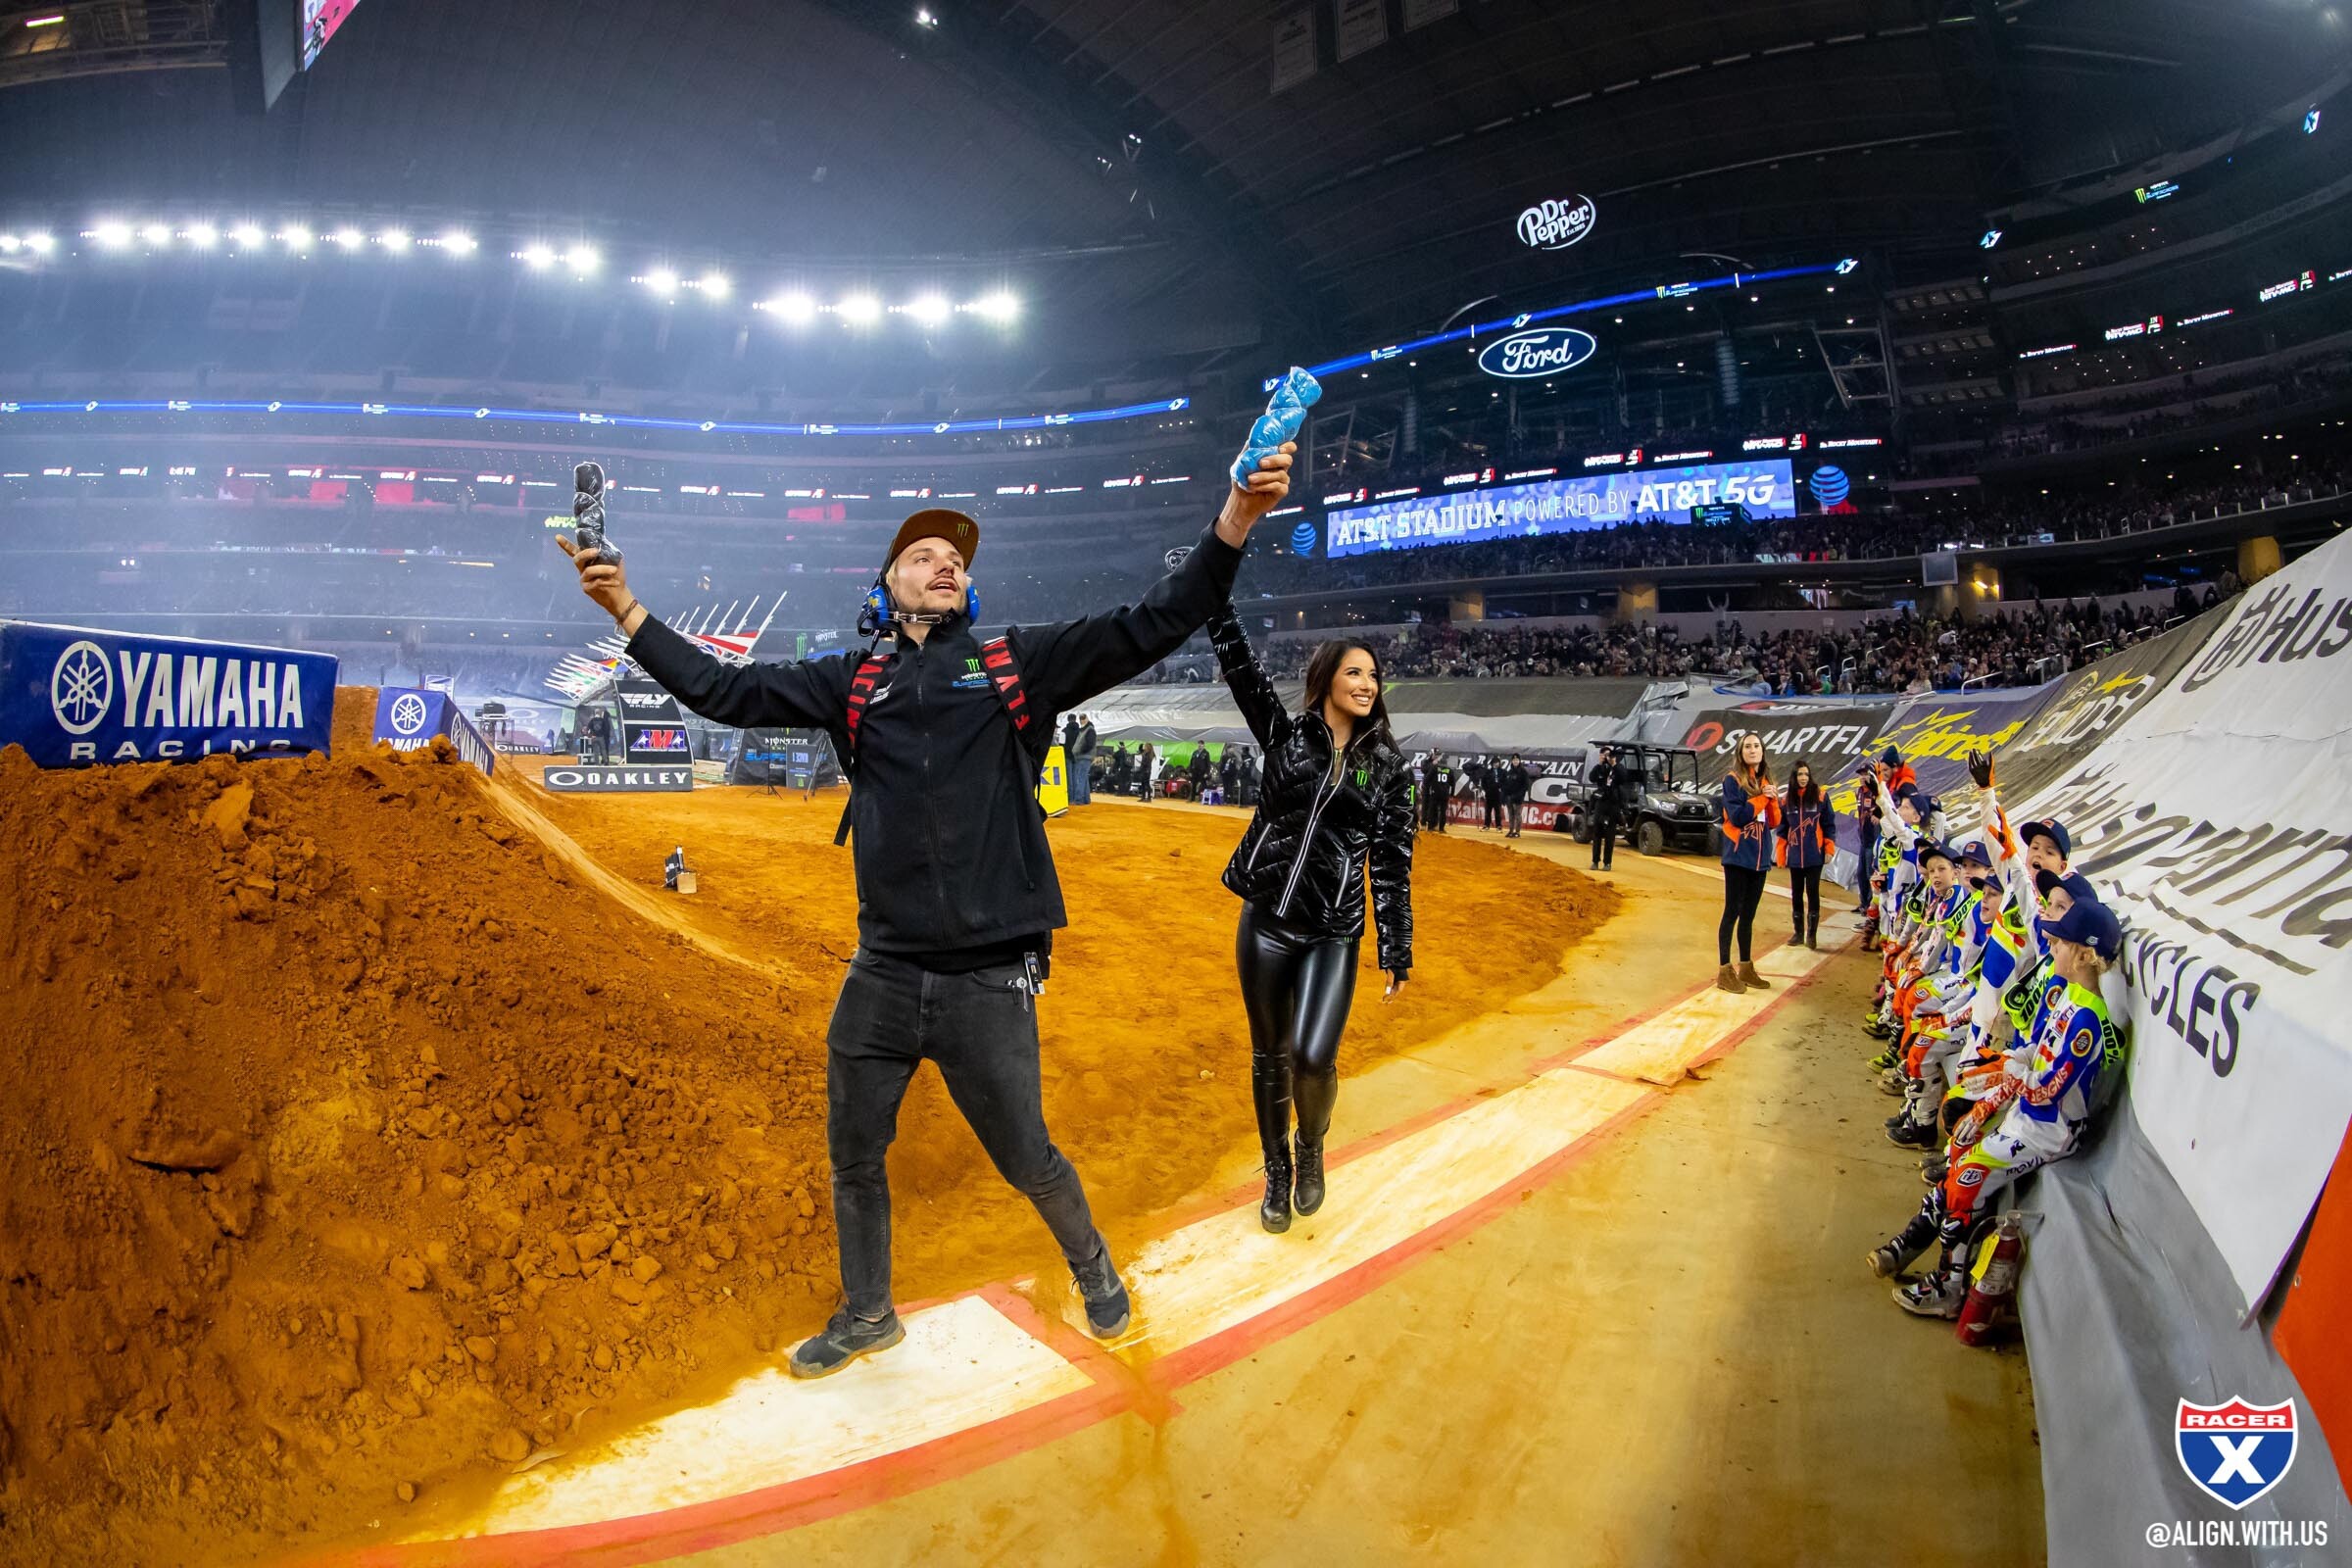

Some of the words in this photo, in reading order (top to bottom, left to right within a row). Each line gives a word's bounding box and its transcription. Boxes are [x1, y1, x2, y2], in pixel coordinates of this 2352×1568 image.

[1541, 200, 1569, 224] Dr
[1502, 335, 1573, 372] Ford
[1337, 514, 1392, 546] AT&T
[1397, 500, 1506, 538] STADIUM
[1514, 493, 1599, 522] POWERED
[1608, 490, 1630, 514] BY
[1636, 478, 1717, 514] AT&T
[1723, 473, 1776, 506] 5G
[120, 650, 304, 728] YAMAHA
[619, 693, 672, 706] FLY
[71, 740, 291, 760] RACING
[629, 729, 687, 750] AMA
[764, 737, 808, 746] MONSTER
[1716, 725, 1868, 755] SARTFI.
[587, 771, 688, 785] OAKLEY
[1437, 773, 1448, 783] 10
[2100, 1015, 2124, 1065] 100%
